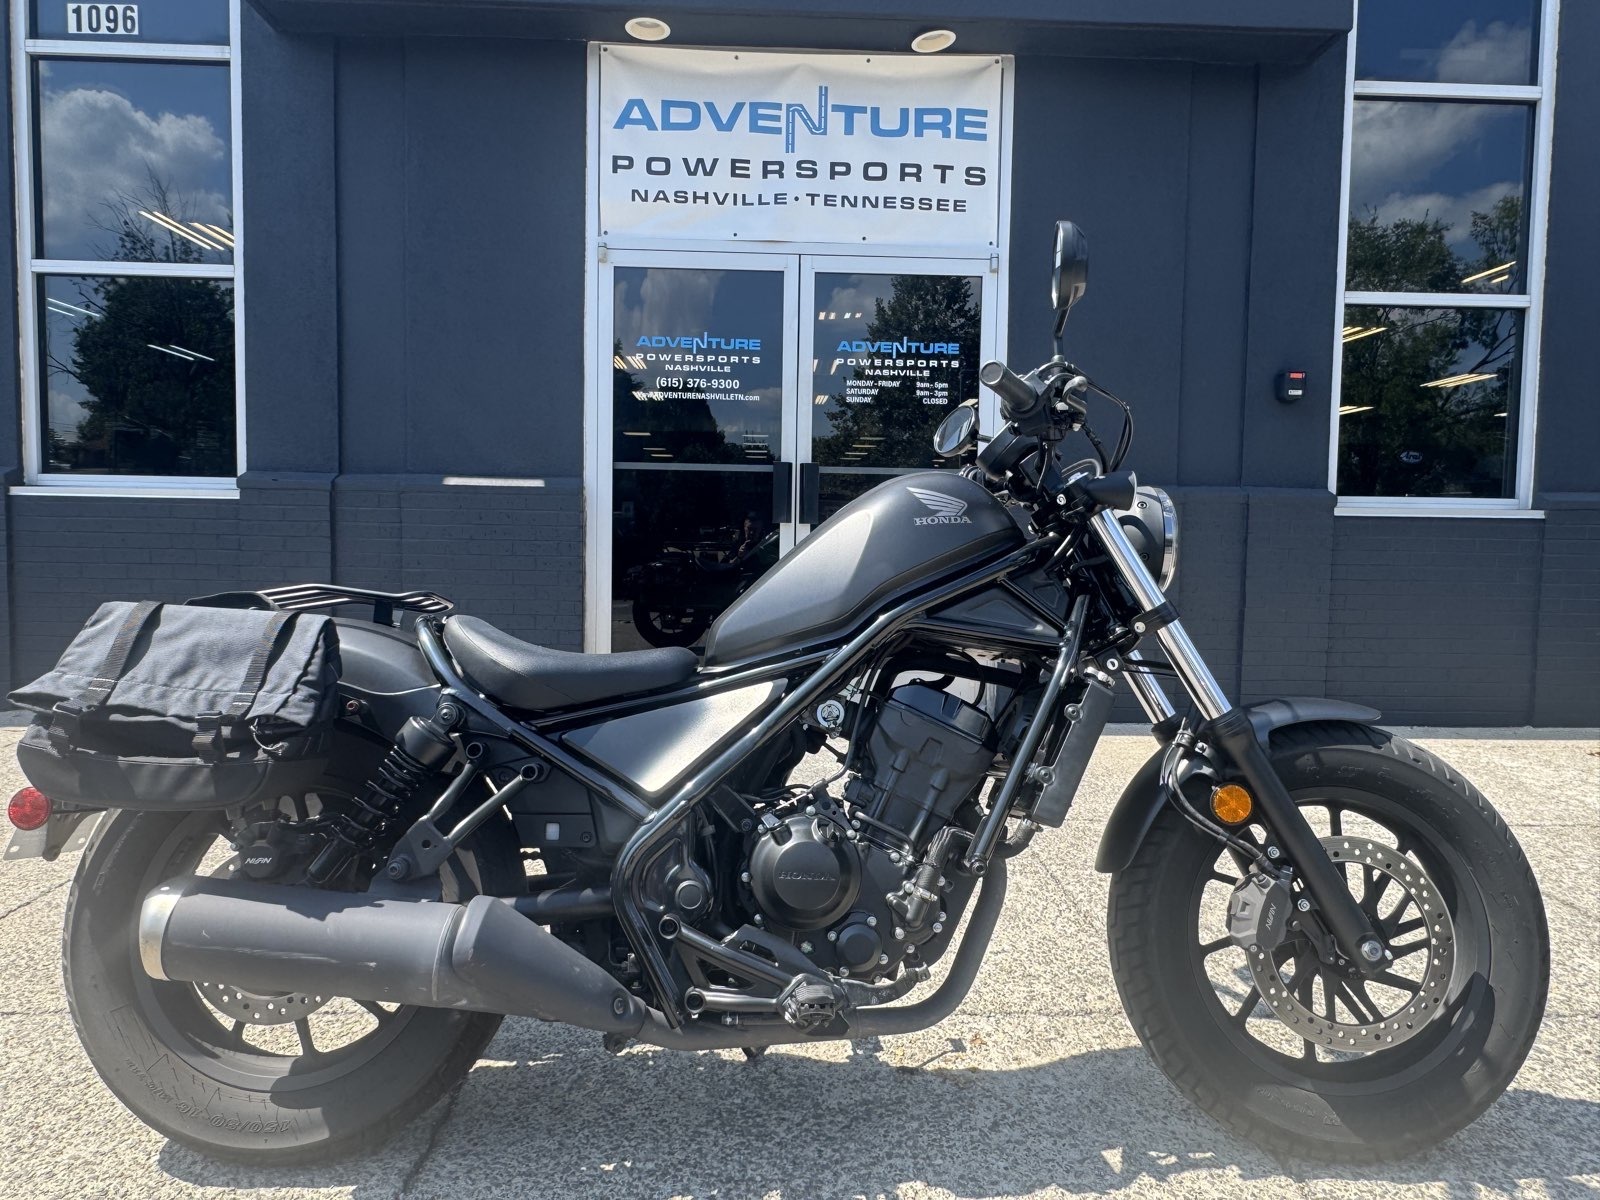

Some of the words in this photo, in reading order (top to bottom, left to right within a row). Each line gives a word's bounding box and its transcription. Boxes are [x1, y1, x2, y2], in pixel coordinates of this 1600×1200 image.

[71, 5, 136, 33] 1096
[612, 85, 988, 153] ADVENTURE
[611, 155, 987, 186] POWERSPORTS
[631, 189, 788, 206] NASHVILLE
[806, 193, 967, 213] TENNESSEE
[636, 332, 761, 354] ADVENTURE
[837, 336, 960, 359] ADVENTURE
[636, 353, 760, 364] POWERSPORTS
[836, 358, 960, 368] POWERSPORTS
[665, 364, 731, 373] NASHVILLE
[865, 369, 930, 377] NASHVILLE
[656, 377, 683, 389] (615)
[686, 378, 740, 389] 376-9300
[846, 387, 879, 396] SATURDAY
[922, 397, 949, 405] CLOSED
[913, 515, 972, 526] HONDA
[777, 871, 837, 881] HONDA
